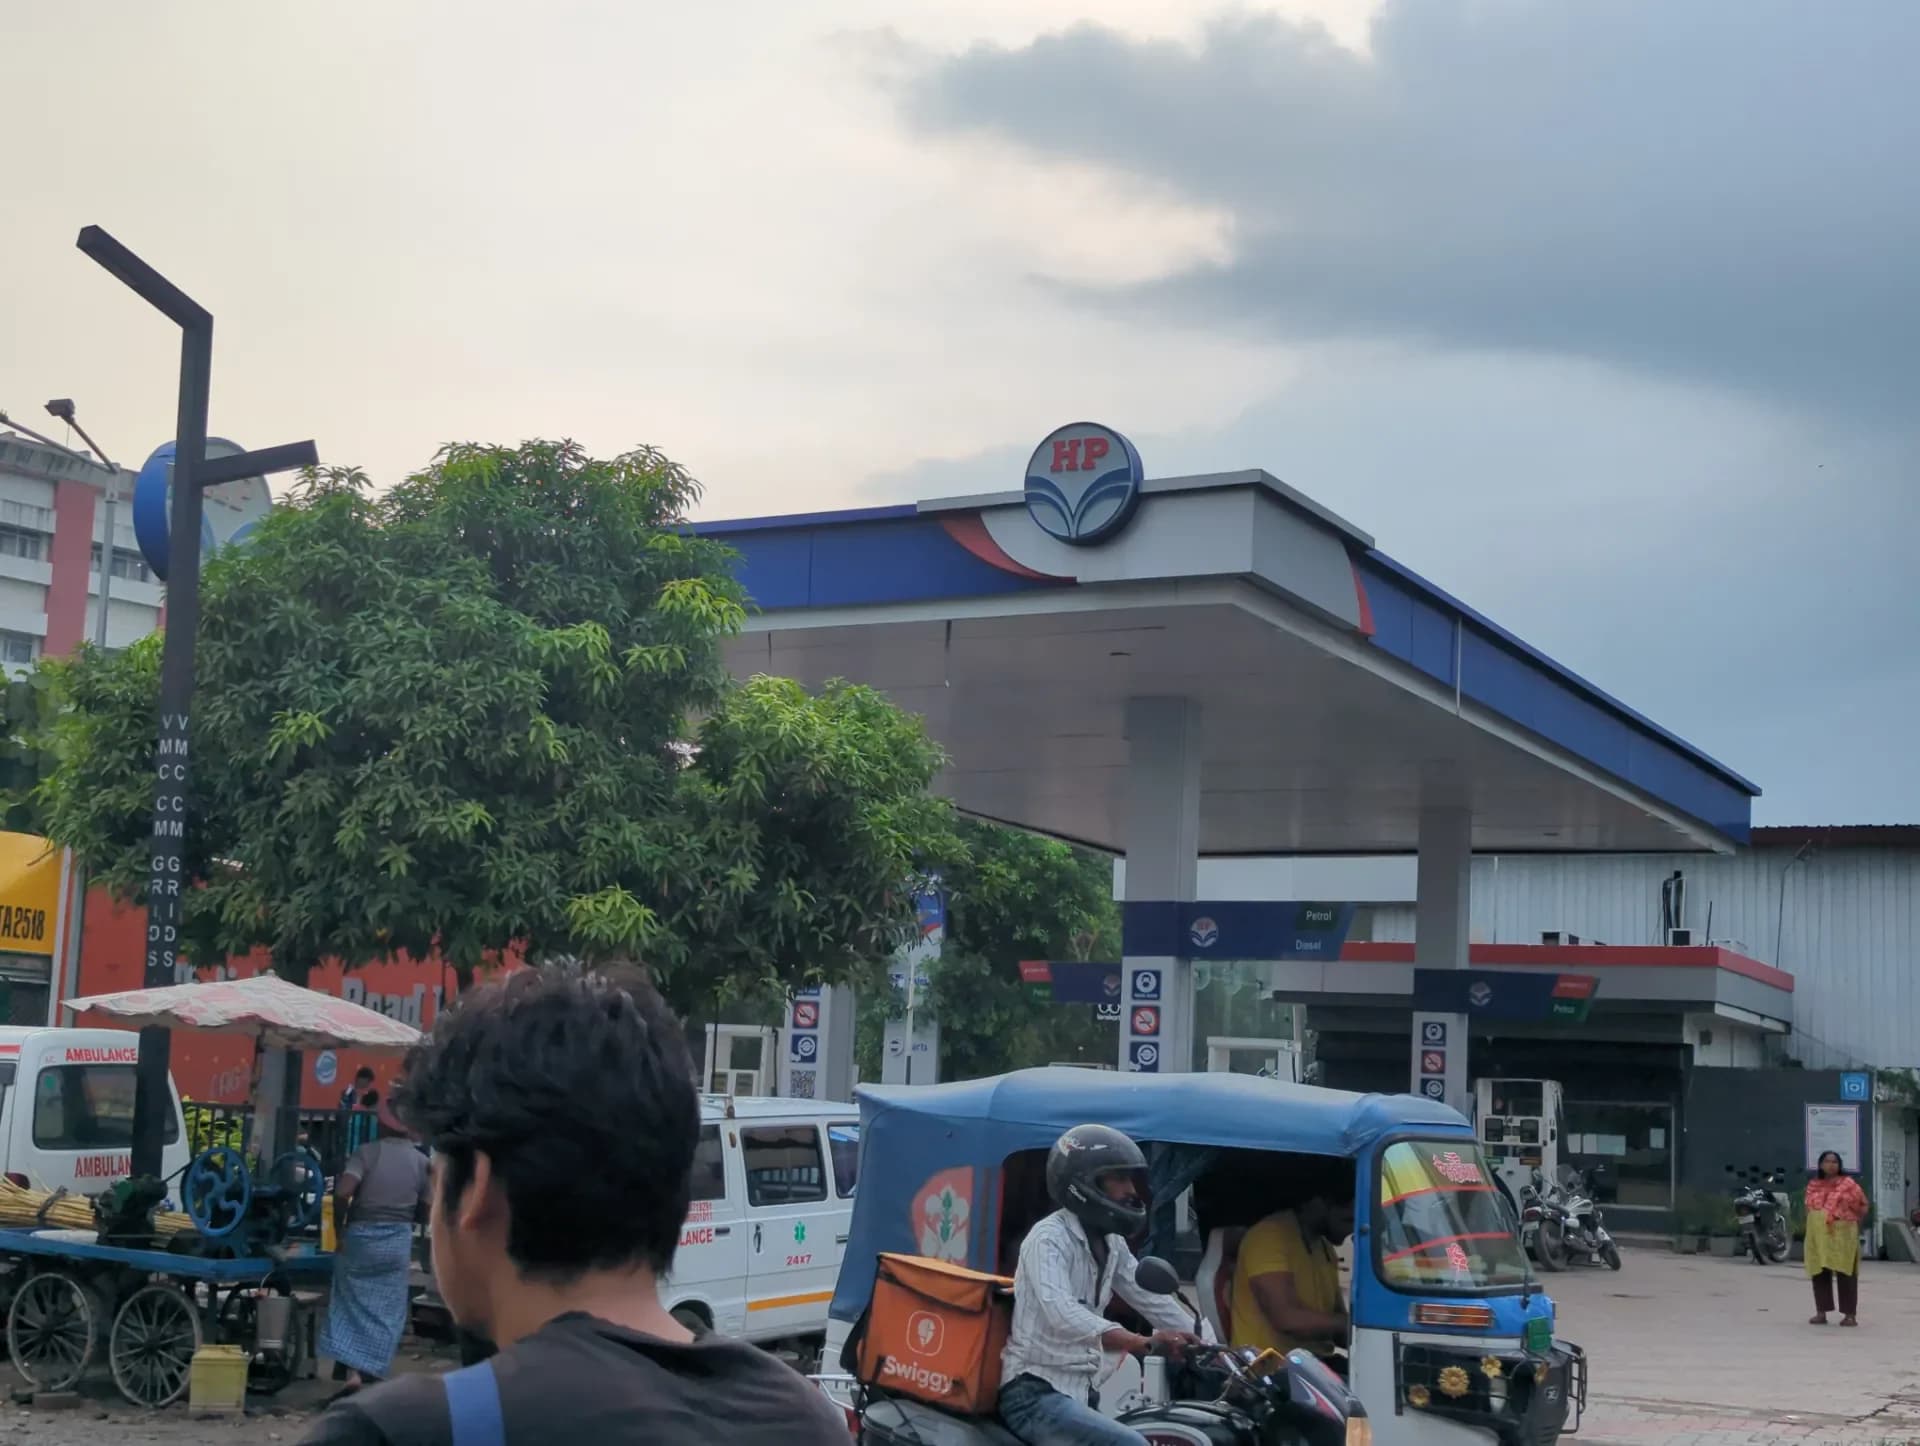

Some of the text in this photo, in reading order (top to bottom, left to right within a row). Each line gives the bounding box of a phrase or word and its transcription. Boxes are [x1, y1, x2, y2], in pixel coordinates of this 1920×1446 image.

[1050, 436, 1110, 473] HP
[1306, 910, 1332, 921] Petrol
[1295, 939, 1322, 951] Diesel
[65, 1047, 138, 1062] AMBULANCE
[883, 1355, 953, 1394] Swiggy
